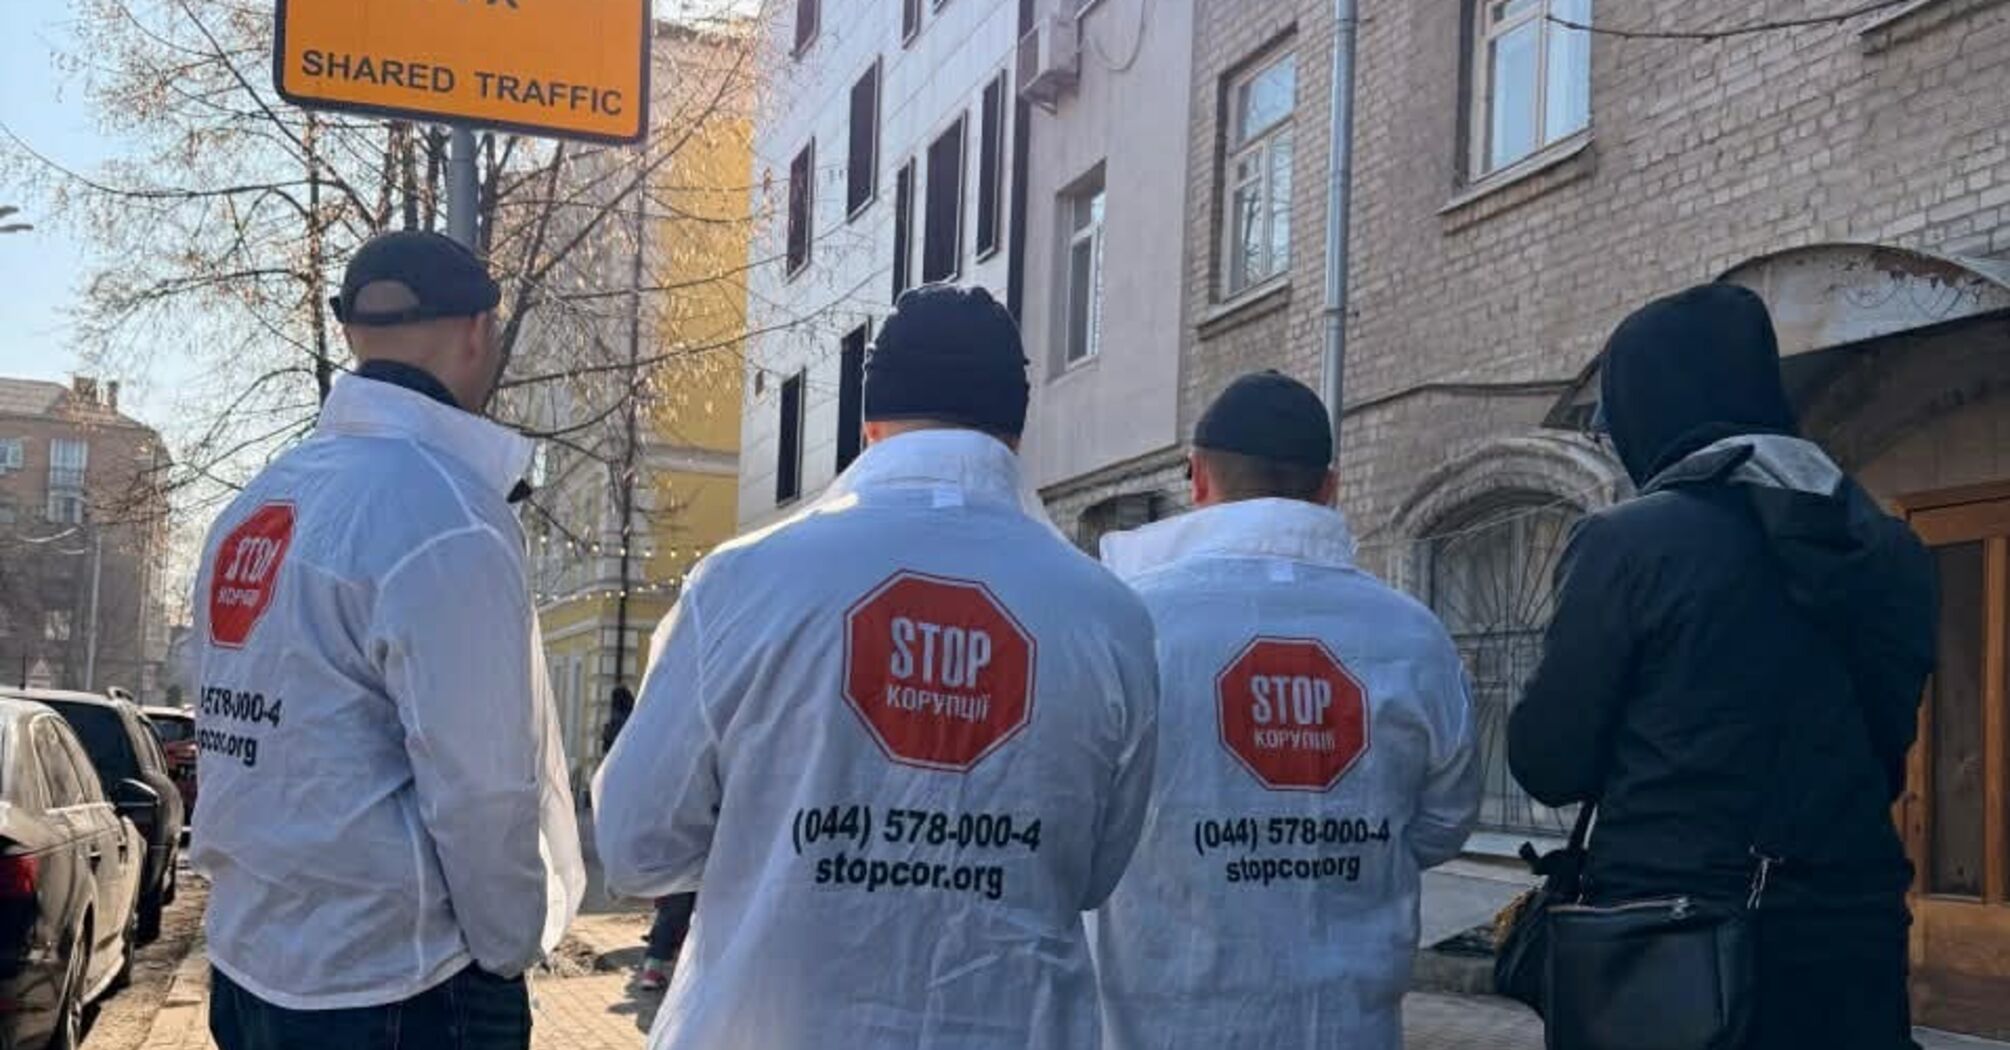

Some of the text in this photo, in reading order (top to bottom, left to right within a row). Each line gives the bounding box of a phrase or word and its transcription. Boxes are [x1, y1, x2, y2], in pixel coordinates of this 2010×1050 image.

[301, 49, 622, 116] SHARED TRAFFIC
[890, 616, 992, 689] STOP
[886, 684, 992, 723] КОРУПЦІЇ
[1250, 674, 1333, 726] STOP
[792, 805, 1042, 855] (044) 578-000-4
[1194, 816, 1391, 856] (044) 578-000-4
[815, 852, 1005, 900] stopcor.org
